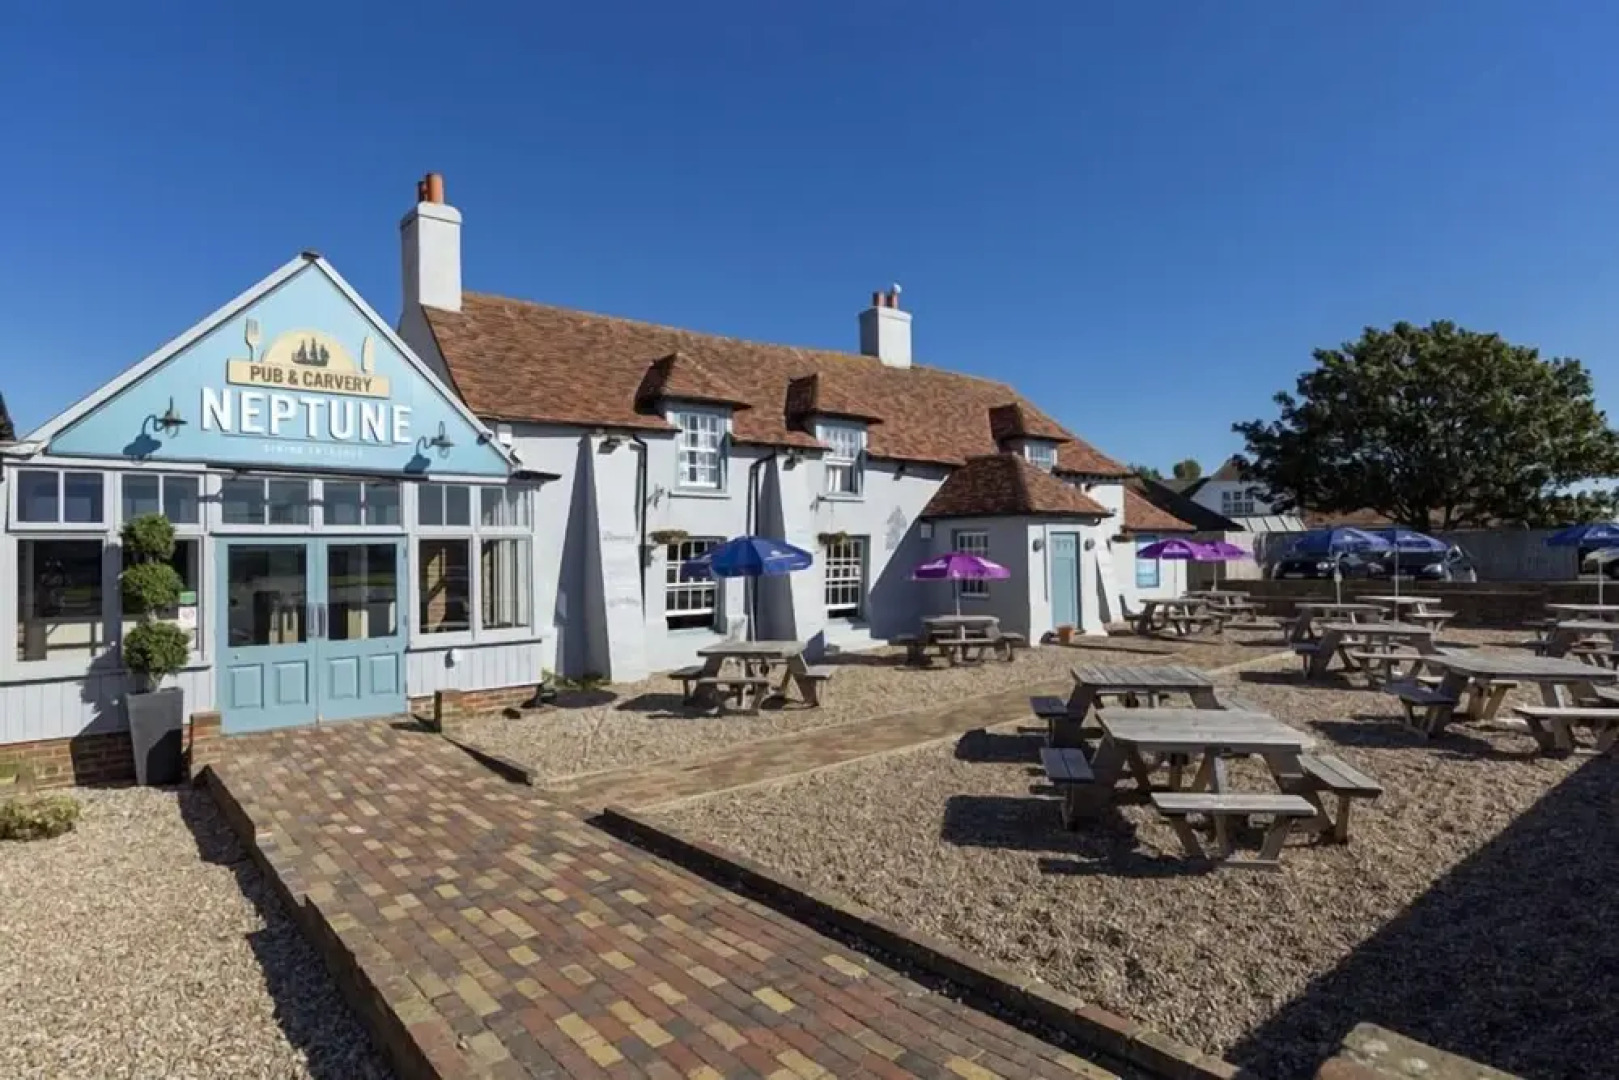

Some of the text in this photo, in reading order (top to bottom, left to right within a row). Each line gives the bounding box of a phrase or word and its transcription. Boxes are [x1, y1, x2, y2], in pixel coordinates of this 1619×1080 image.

[250, 365, 372, 392] PUB & CARVERY
[201, 387, 413, 443] NEPTUNE
